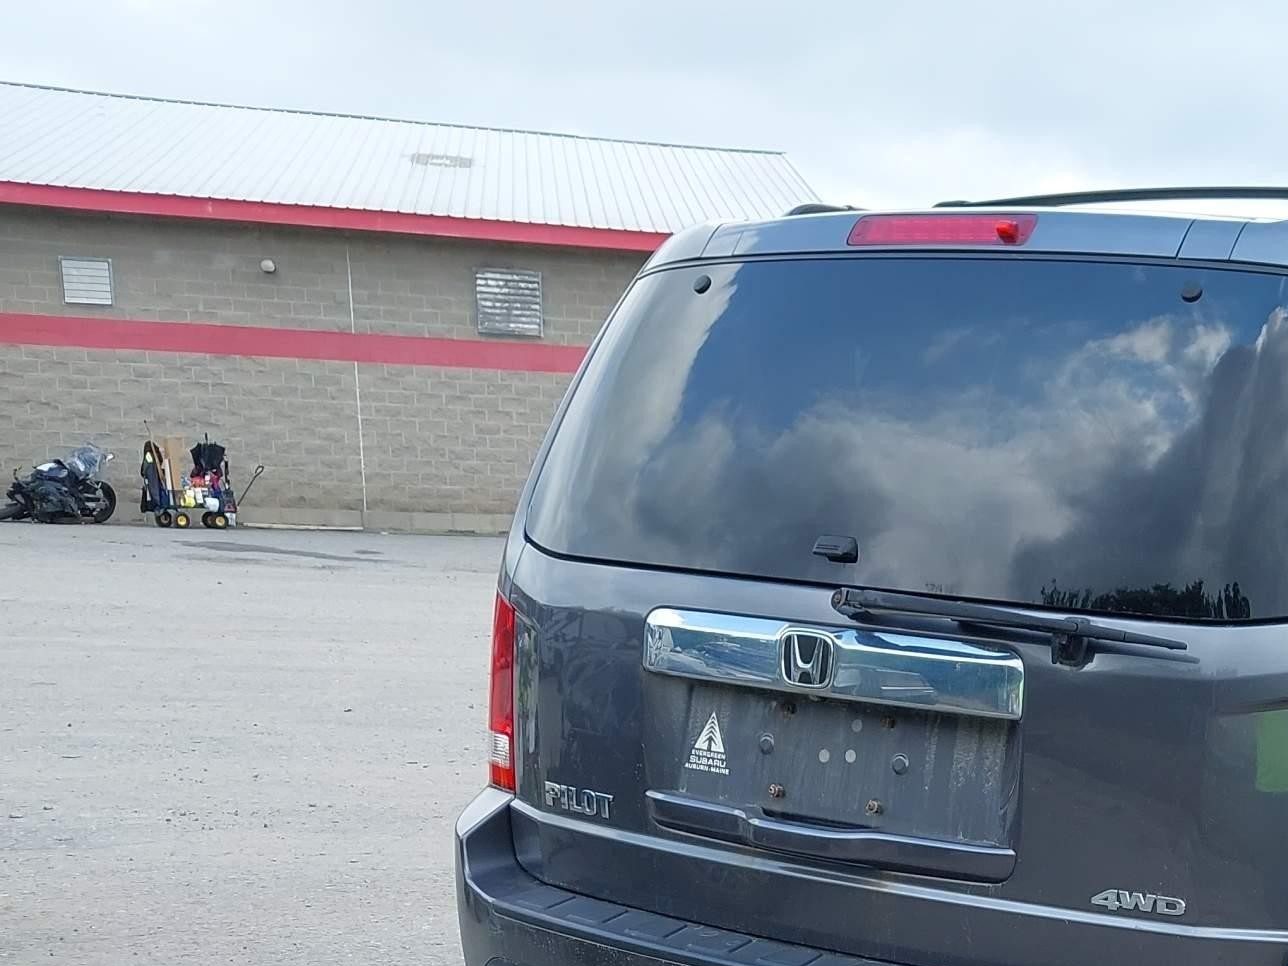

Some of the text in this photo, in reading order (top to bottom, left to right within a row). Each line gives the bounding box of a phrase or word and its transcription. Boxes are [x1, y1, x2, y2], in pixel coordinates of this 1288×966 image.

[689, 754, 727, 768] SUBARU
[691, 748, 726, 760] EVERGREEN
[544, 780, 614, 820] PILOT
[1091, 889, 1186, 916] 4WD
